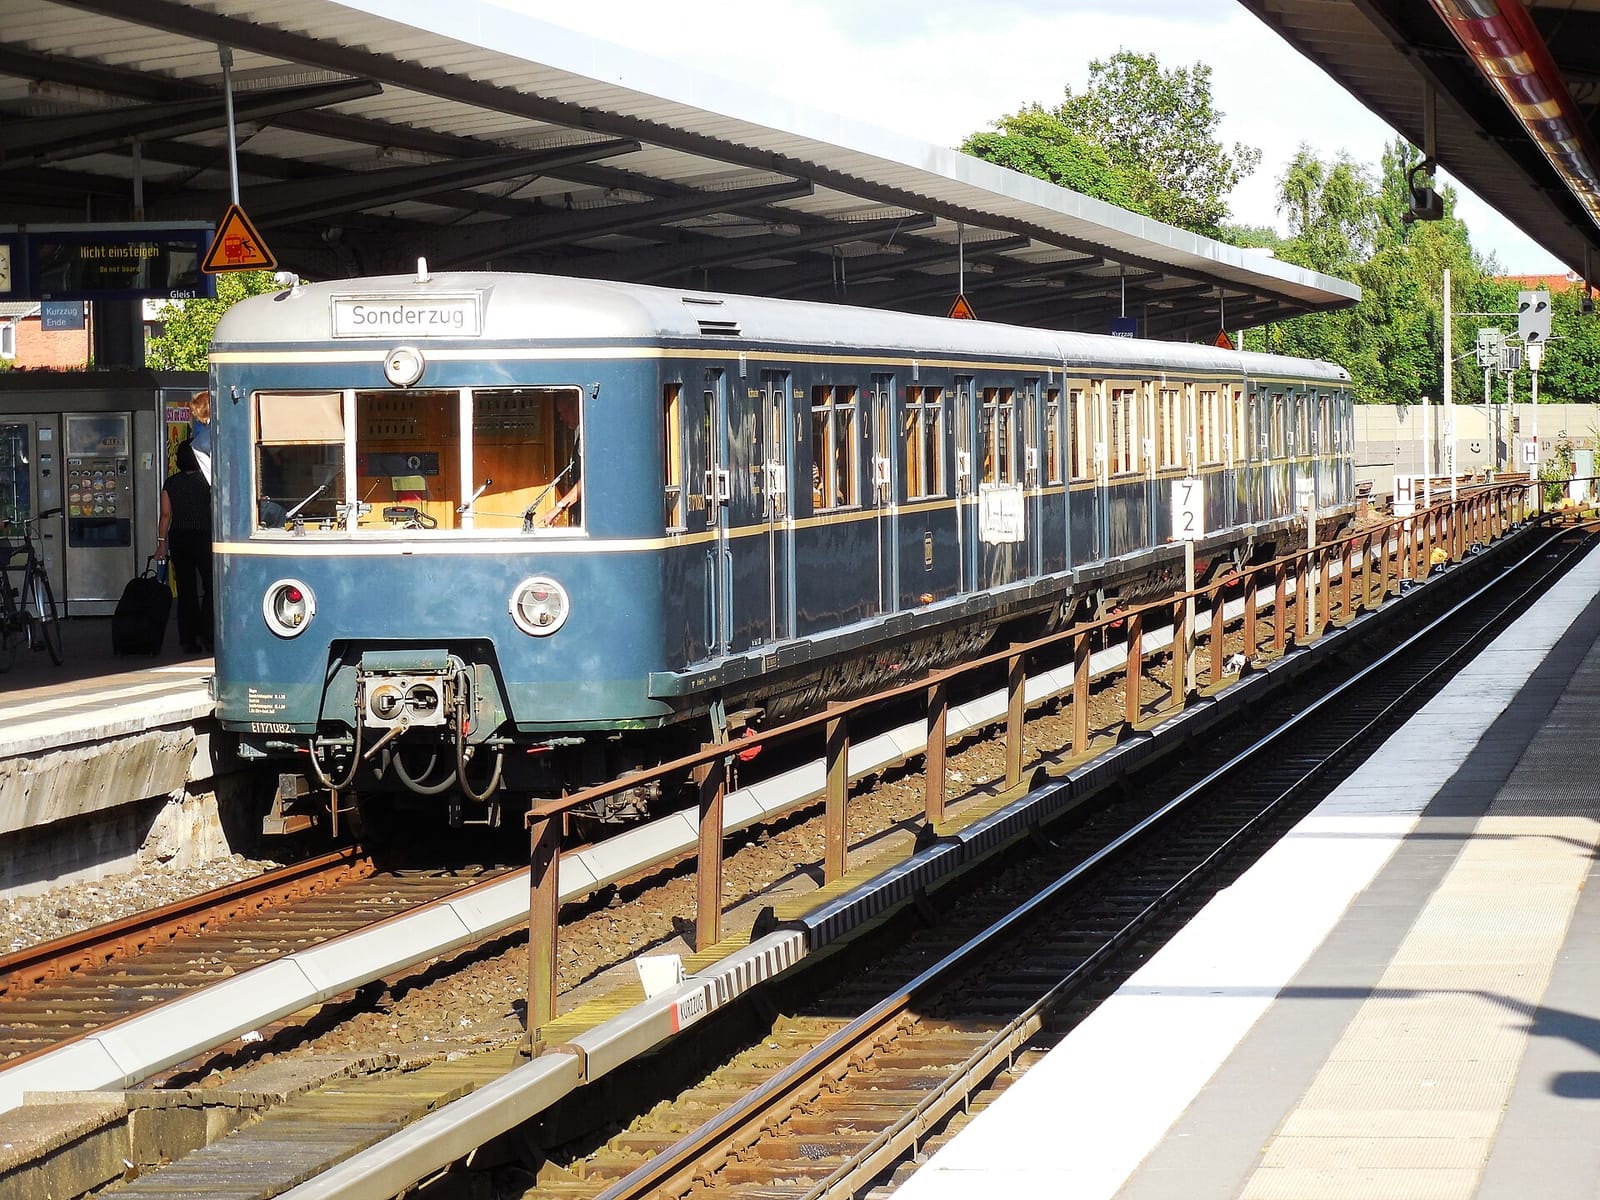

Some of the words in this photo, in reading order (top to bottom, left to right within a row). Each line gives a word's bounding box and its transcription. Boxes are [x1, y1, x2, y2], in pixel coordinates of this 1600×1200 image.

[80, 246, 105, 258] Nicht
[108, 245, 159, 260] einsteigen
[170, 290, 191, 299] Gleis
[46, 307, 78, 317] Kurzzug
[352, 305, 464, 329] Sonderzug
[797, 412, 803, 442] 2
[863, 410, 868, 439] 2
[1525, 445, 1536, 461] H
[1181, 483, 1193, 506] 7
[1397, 478, 1411, 501] H
[1182, 511, 1194, 531] 2
[1401, 581, 1411, 592] 3
[680, 993, 704, 1021] KURZZUG
